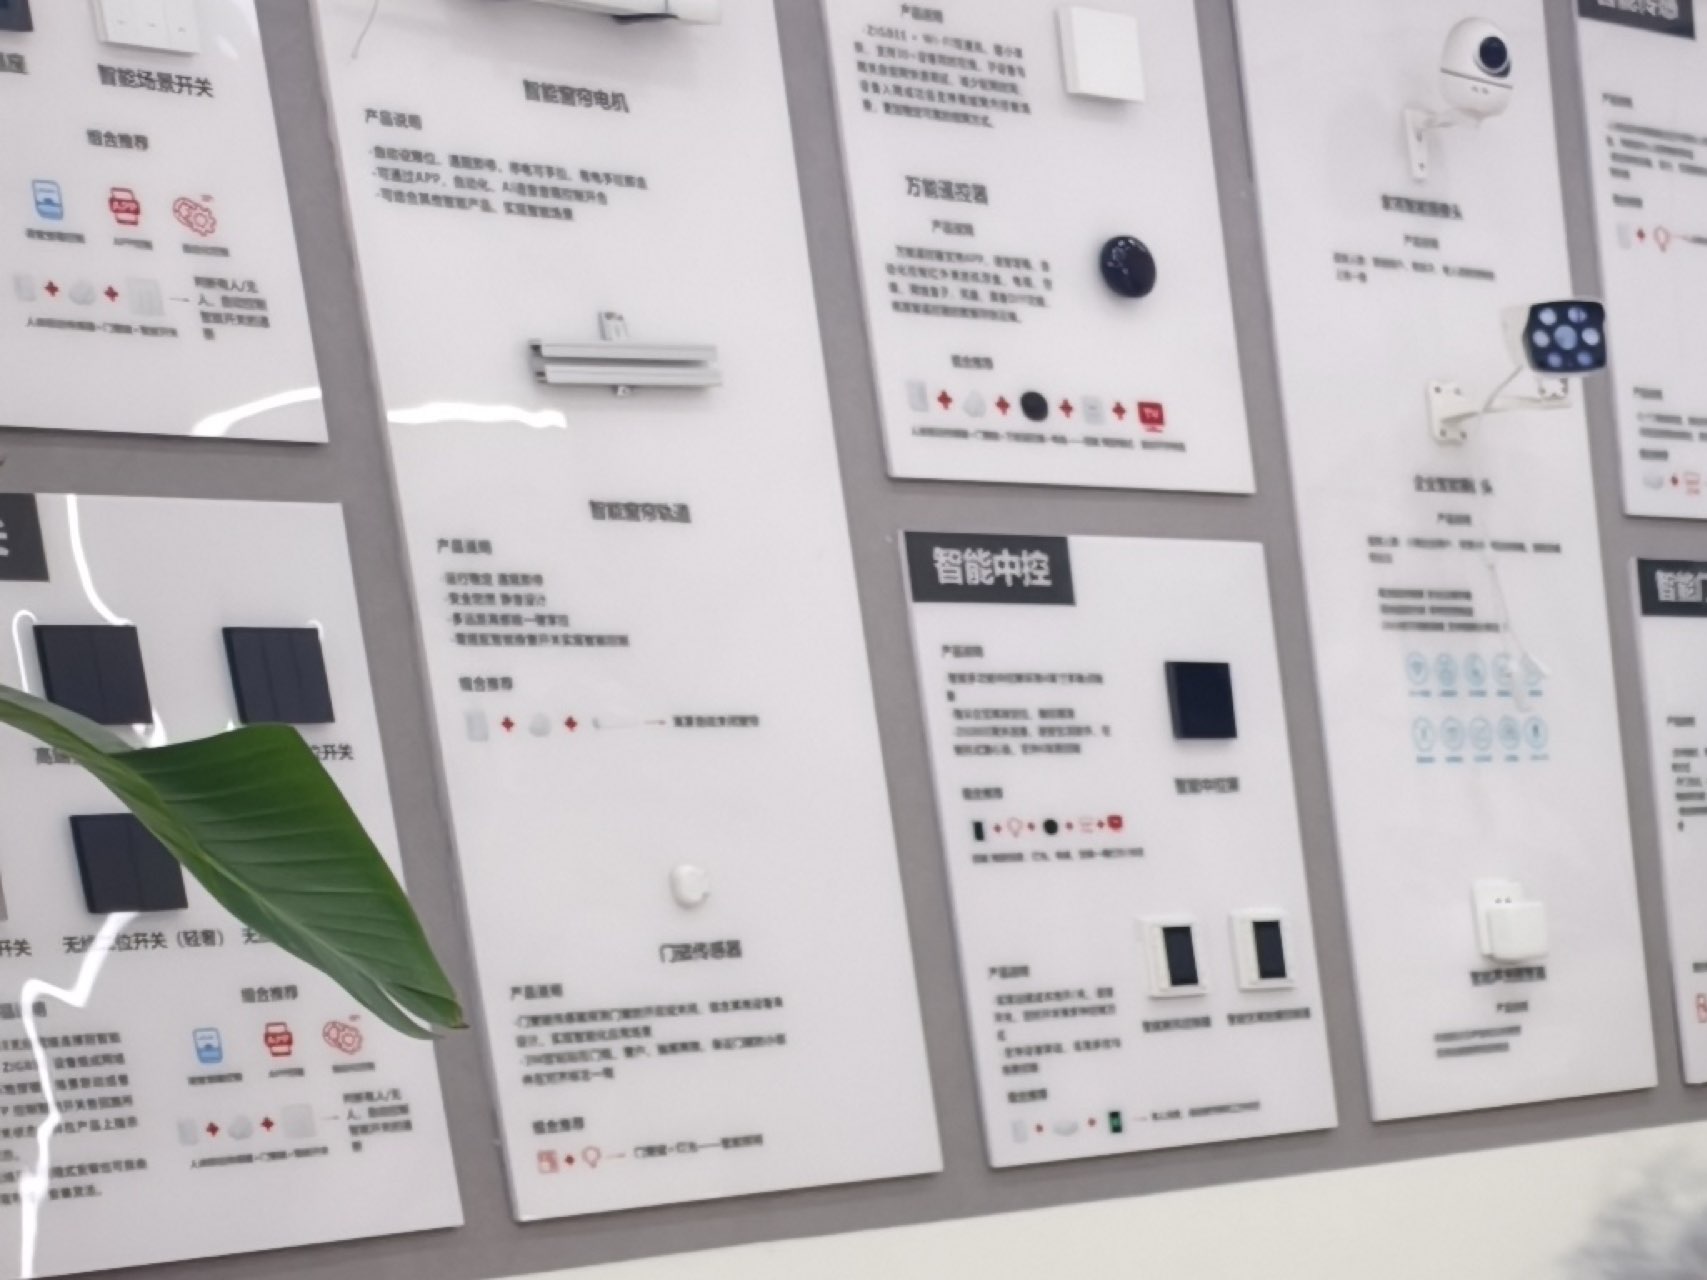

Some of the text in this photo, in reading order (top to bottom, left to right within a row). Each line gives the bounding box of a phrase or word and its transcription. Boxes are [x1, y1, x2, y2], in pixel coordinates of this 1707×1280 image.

[97, 63, 214, 98] 智能场景开关
[523, 79, 630, 113] 智能窗帘电机
[905, 175, 989, 205] 万能遥控器
[589, 500, 692, 524] 智能窗帘轨道
[931, 545, 1053, 588] 智能中控
